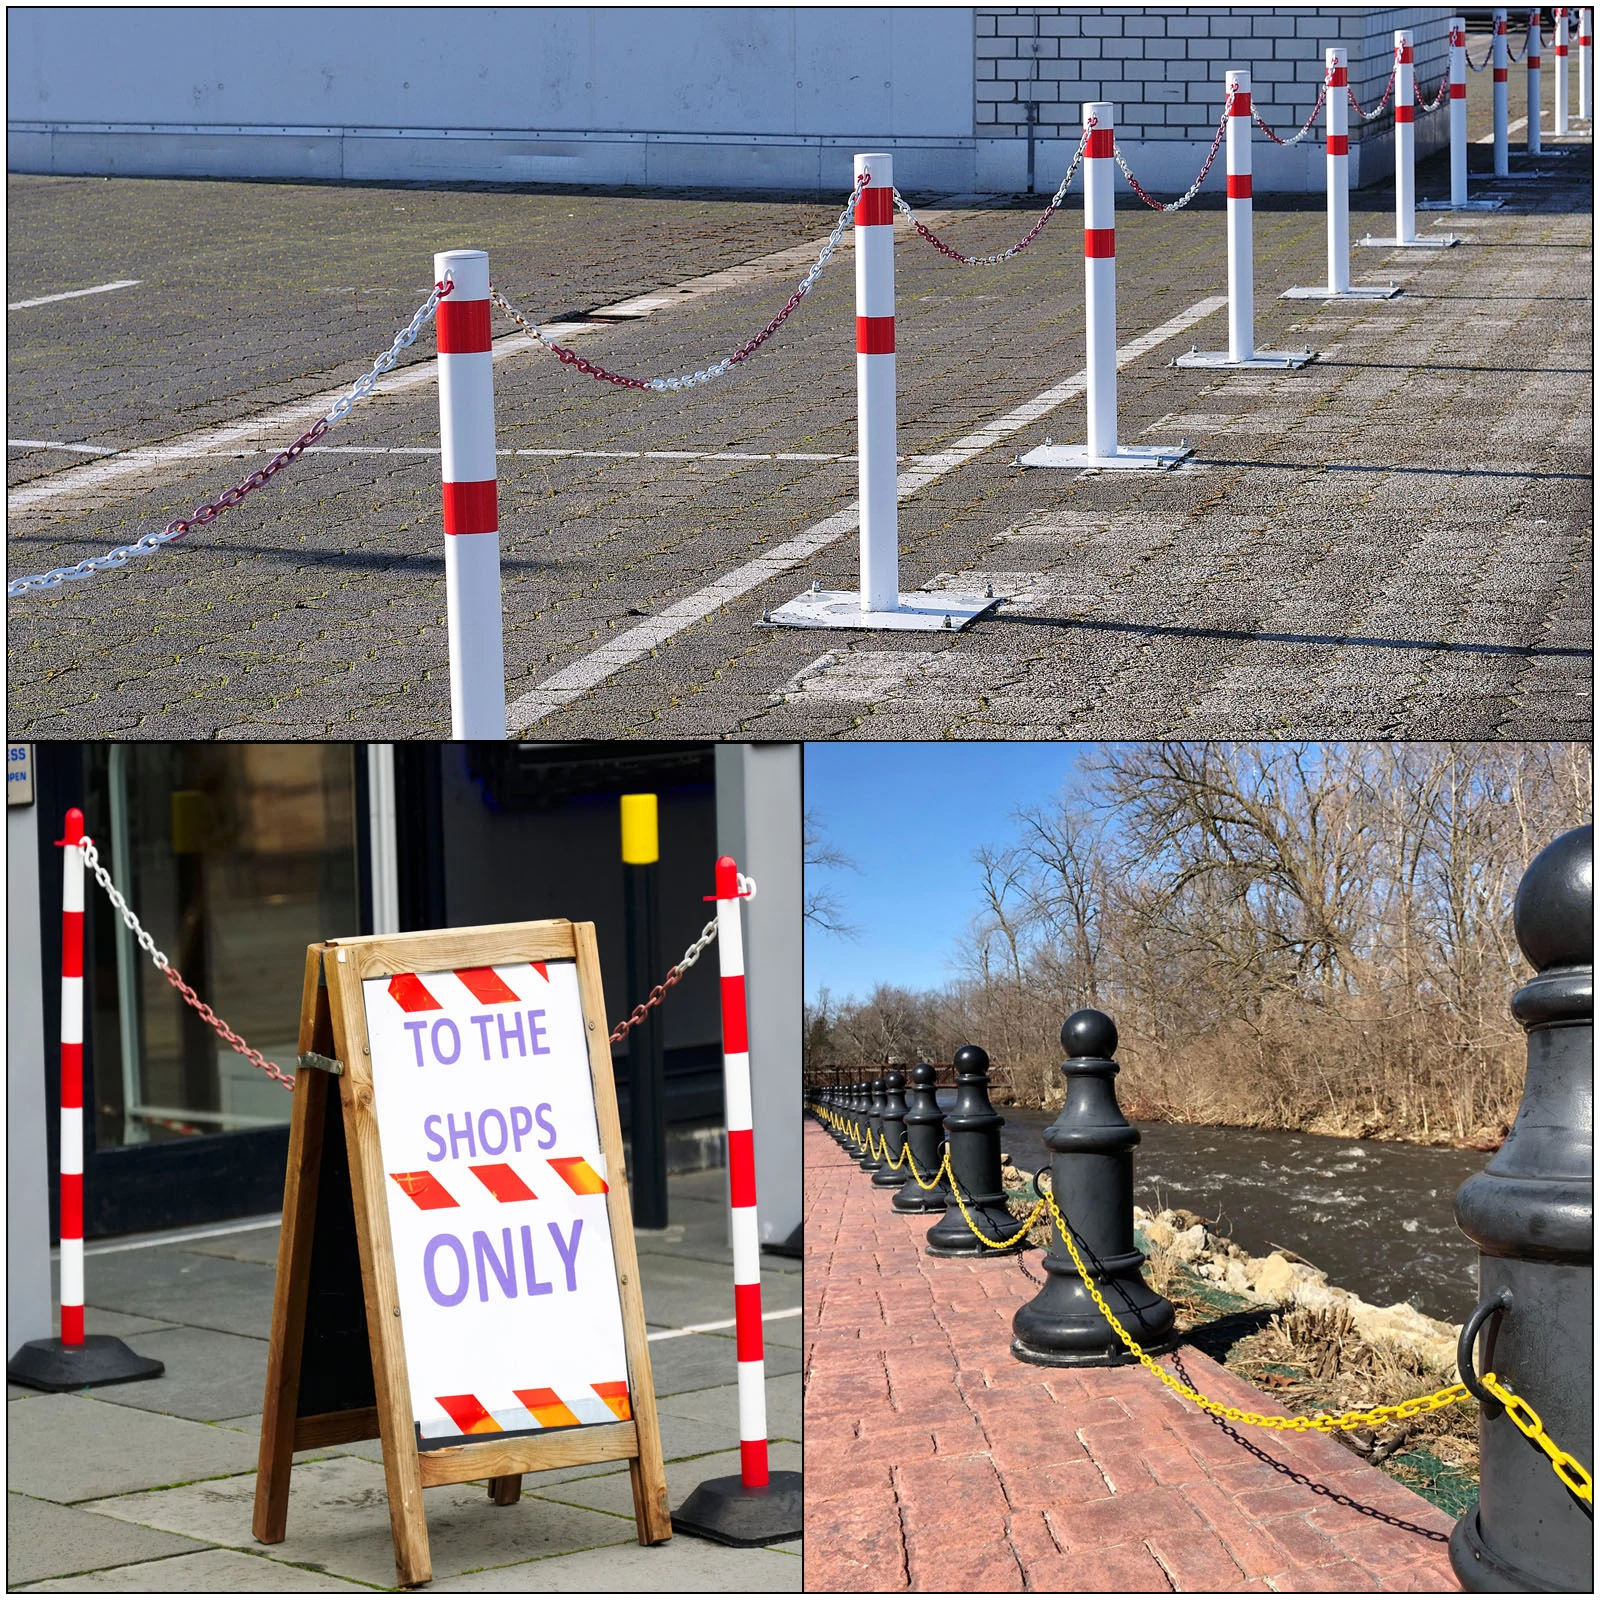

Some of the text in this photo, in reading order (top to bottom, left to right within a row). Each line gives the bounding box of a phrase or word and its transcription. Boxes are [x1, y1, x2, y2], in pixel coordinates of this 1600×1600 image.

[8, 748, 26, 761] SS
[8, 772, 27, 781] PEN
[404, 1009, 550, 1067] TO THE
[424, 1102, 557, 1162] SHOPS
[423, 1219, 584, 1307] ONLY
